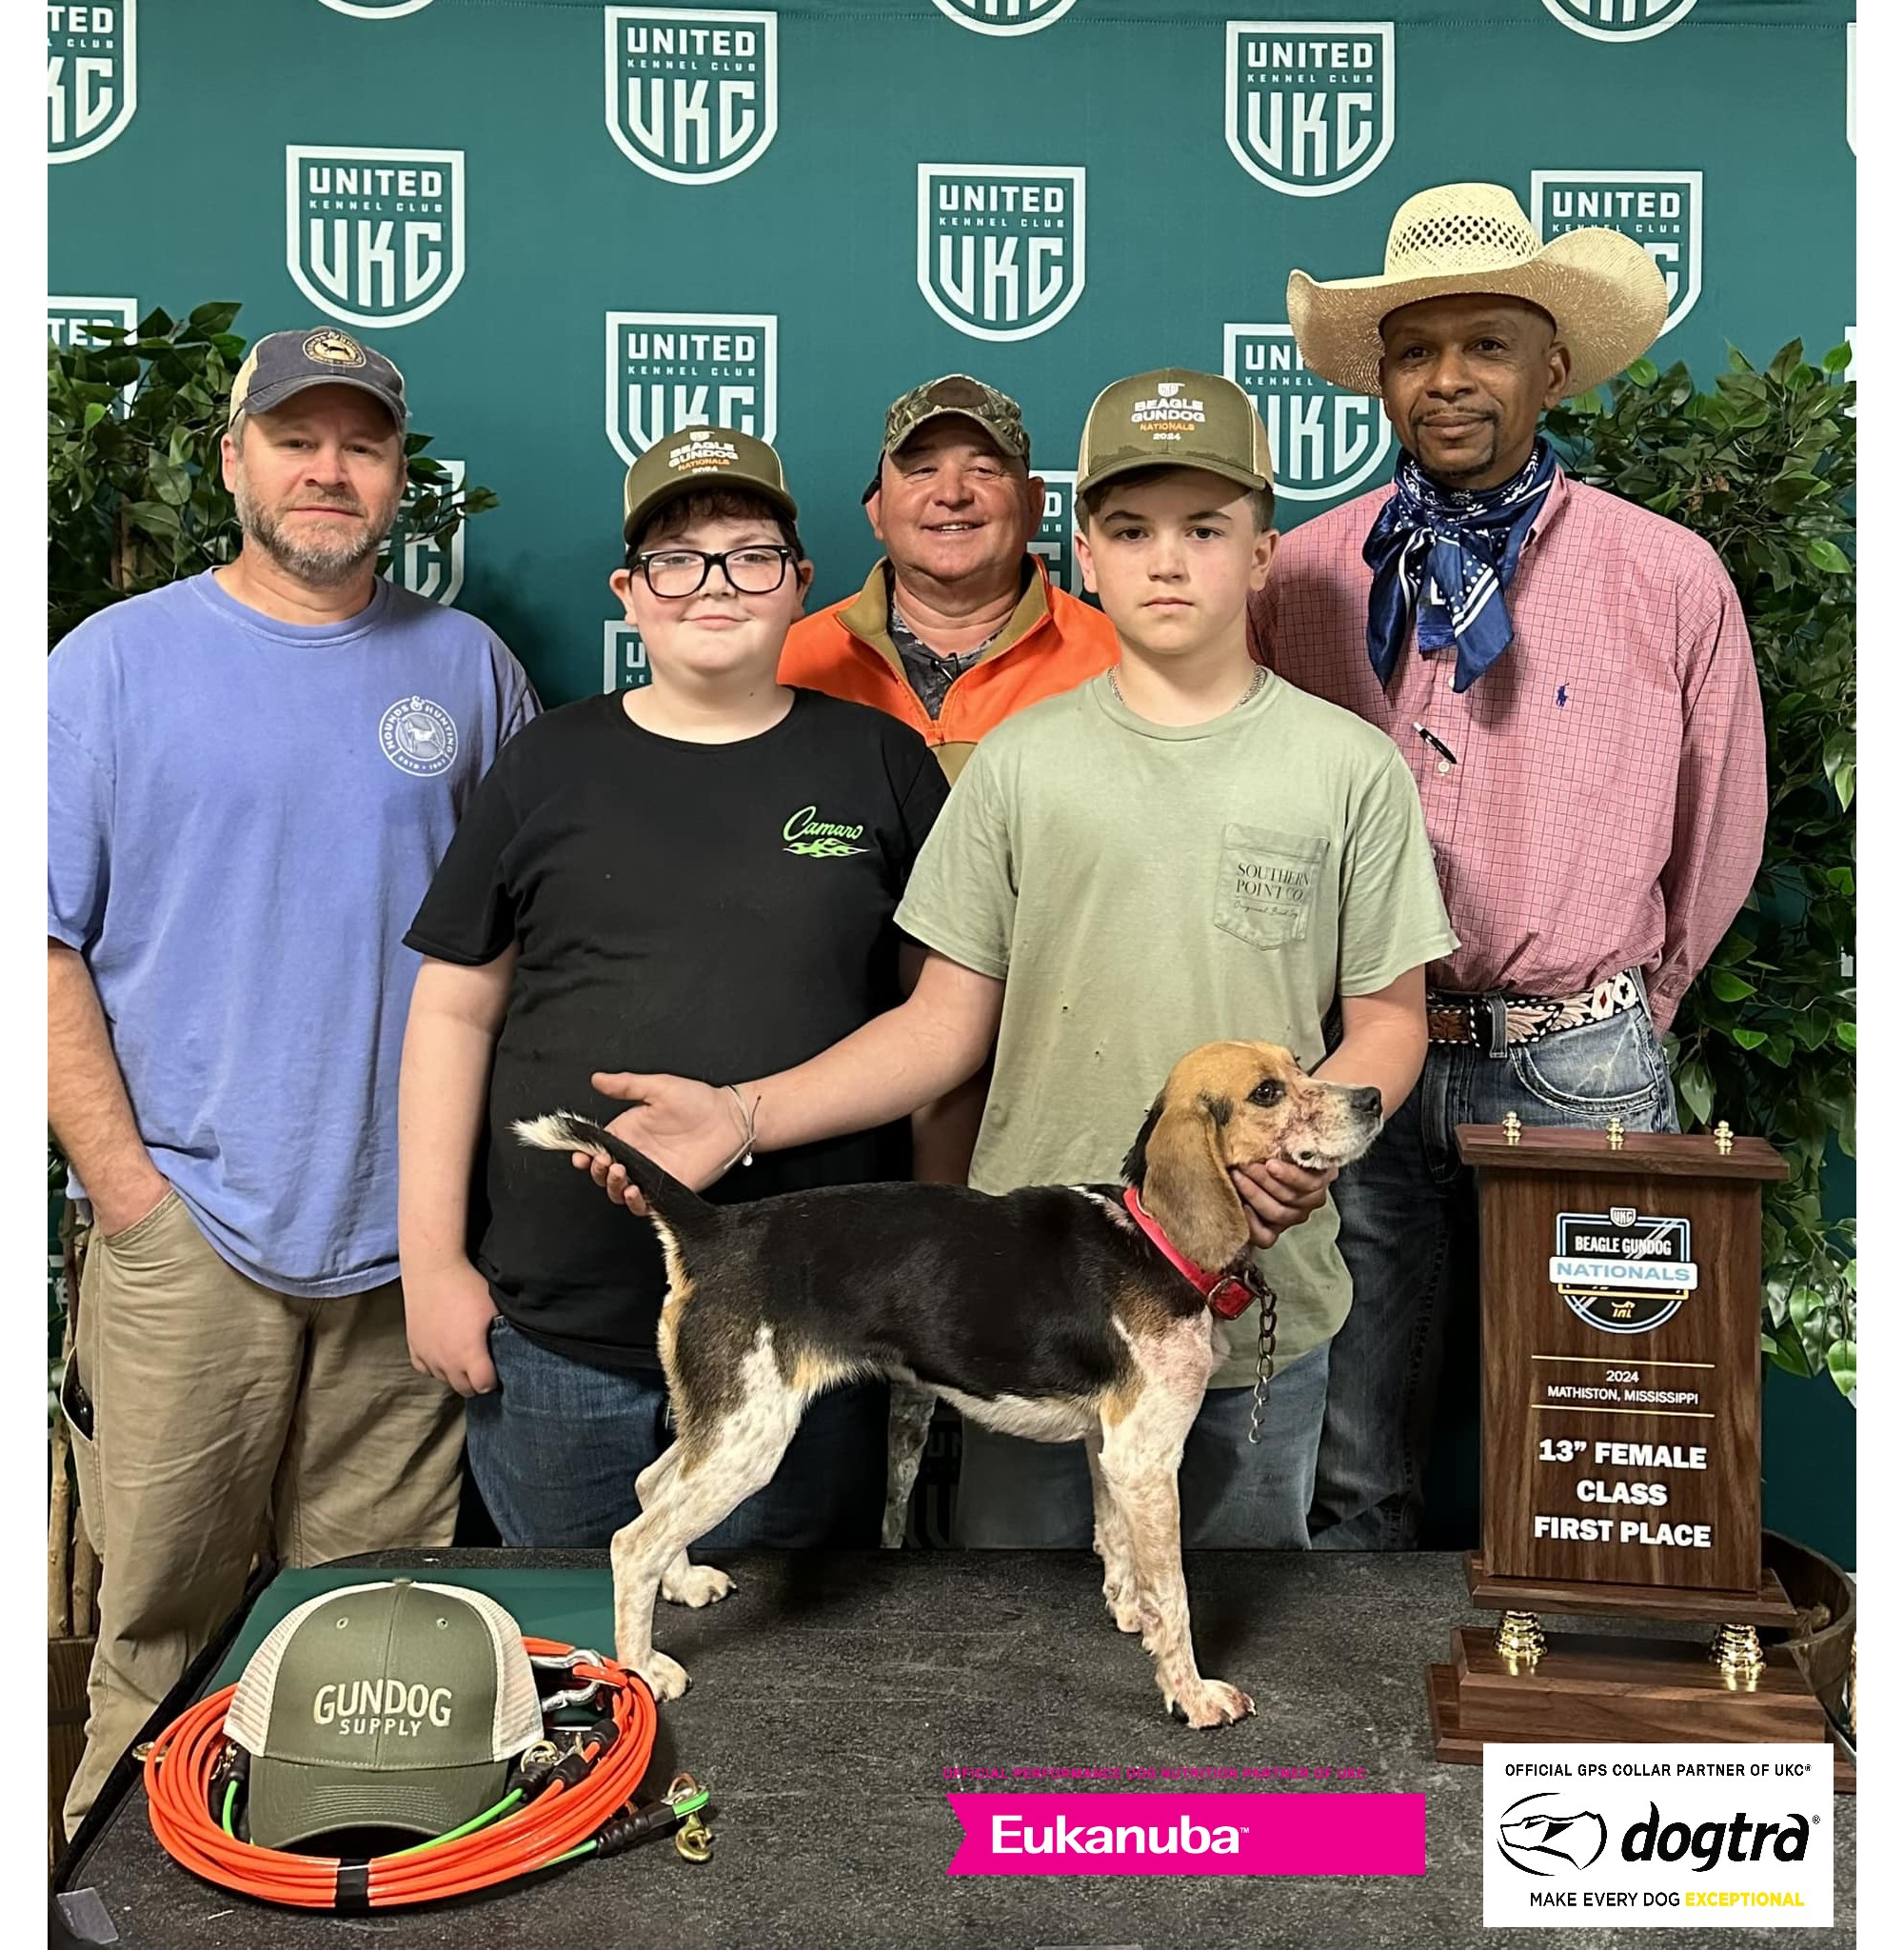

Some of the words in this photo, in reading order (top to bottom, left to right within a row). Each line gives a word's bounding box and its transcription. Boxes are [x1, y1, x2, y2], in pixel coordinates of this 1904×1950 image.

[48, 6, 113, 33] TED
[67, 39, 113, 49] CLUB
[627, 28, 754, 57] UNITED
[626, 59, 698, 70] KENNEL
[711, 62, 755, 72] CLUB
[1247, 43, 1373, 69] UNITED
[1247, 74, 1316, 83] KENNEL
[1329, 75, 1373, 84] CLUB
[48, 56, 113, 143] KC
[627, 77, 755, 164] UKC
[1247, 92, 1373, 177] UKC
[310, 167, 442, 197] UNITED
[310, 200, 382, 211] KENNEL
[396, 203, 443, 213] CLUB
[939, 185, 1063, 212] UNITED
[1553, 192, 1680, 218] UNITED
[939, 217, 1007, 228] KENNEL
[1021, 218, 1064, 229] CLUB
[1636, 225, 1680, 233] CLUB
[310, 219, 442, 307] UKC
[940, 235, 1063, 321] UKC
[48, 318, 114, 346] TED
[628, 333, 755, 362] UNITED
[1245, 345, 1304, 371] UNI
[628, 366, 698, 376] KENNEL
[711, 368, 756, 377] CLUB
[1245, 377, 1313, 387] KENNEL
[1131, 409, 1206, 423] GUNDOG
[1134, 398, 1204, 412] BEAGLE
[1140, 422, 1196, 431] NATIONALS
[668, 448, 739, 468] GUNDOG
[678, 457, 731, 471] NATIONALS
[384, 705, 409, 750] HOUNDS
[409, 695, 426, 712] &
[425, 705, 455, 753] HUNTING
[783, 806, 863, 842] Camaro
[1237, 863, 1309, 885] SOUTHERN
[1236, 879, 1282, 900] POINT
[1614, 1210, 1633, 1225] UKC
[1575, 1235, 1620, 1253] BEAGLE
[1621, 1238, 1672, 1256] GUNDOG
[1557, 1263, 1691, 1282] NATIONALS
[1605, 1370, 1640, 1383] 2024
[1547, 1385, 1621, 1403] MATHISTON,
[1624, 1389, 1698, 1405] MISSISSIPPI
[1595, 1442, 1707, 1470] FEMALE
[1577, 1480, 1668, 1506] CLASS
[1534, 1515, 1615, 1542] FIRST
[1620, 1521, 1712, 1548] PLACE
[313, 1678, 452, 1727] GUNDOG
[339, 1717, 422, 1737] SUPPLY
